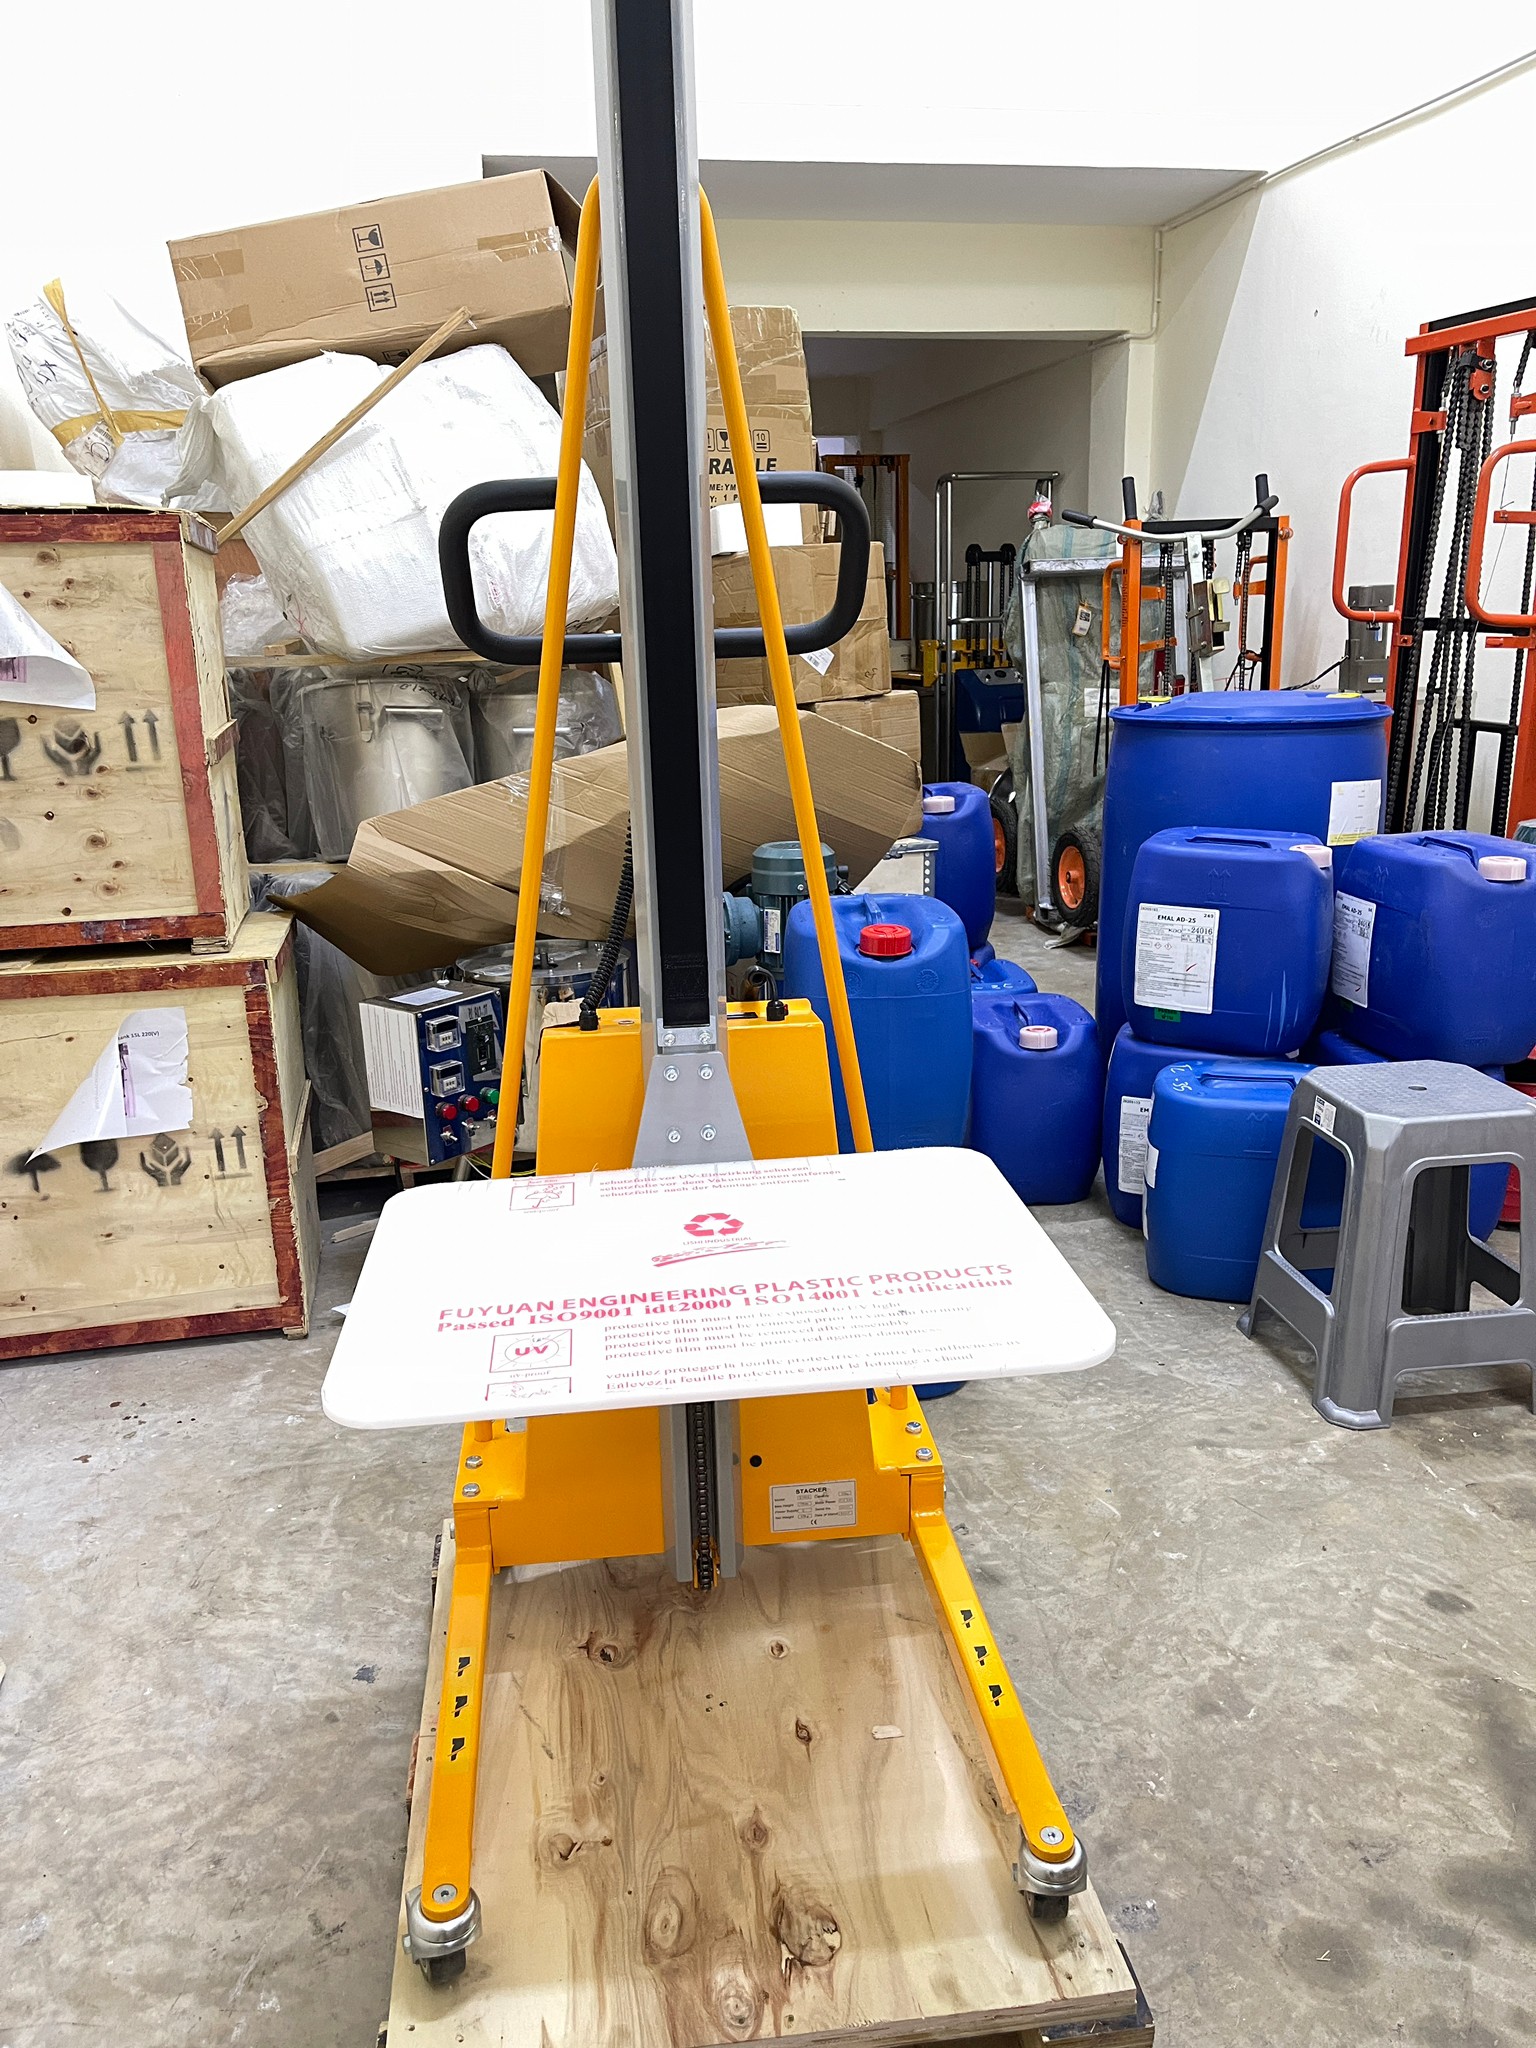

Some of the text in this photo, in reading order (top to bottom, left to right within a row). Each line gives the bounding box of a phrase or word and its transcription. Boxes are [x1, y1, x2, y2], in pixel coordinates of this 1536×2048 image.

[756, 433, 766, 441] 10
[1157, 914, 1175, 922] EMAL
[1191, 926, 1213, 935] 24016
[440, 1264, 1012, 1320] FUYUAN ENGINEERING PLASTIC PRODUCTS
[438, 1279, 1012, 1332] Passed ISO9001 idt2000 ISO14001 certification
[604, 1321, 669, 1332] protective
[604, 1330, 670, 1341] protective
[515, 1345, 549, 1356] UV
[605, 1339, 671, 1351] protective
[605, 1348, 672, 1360] protective
